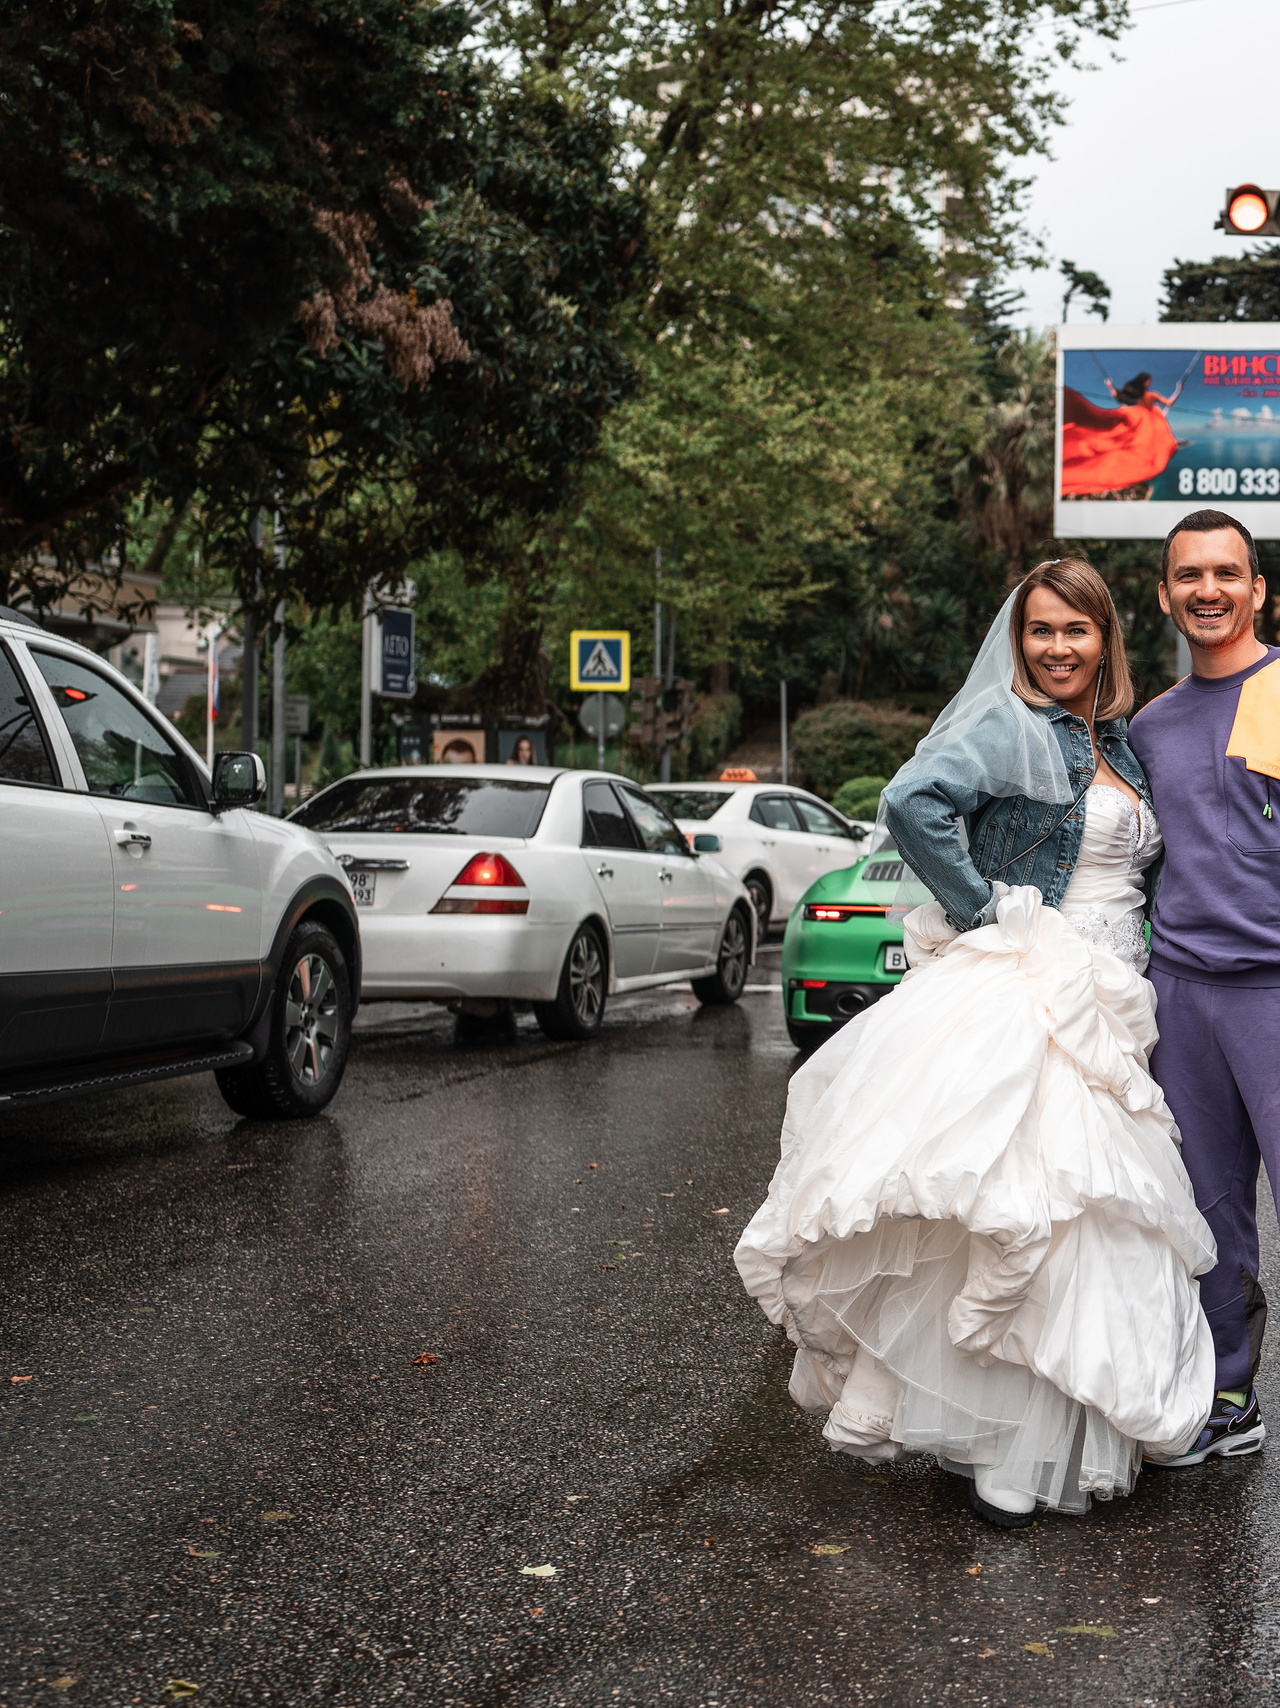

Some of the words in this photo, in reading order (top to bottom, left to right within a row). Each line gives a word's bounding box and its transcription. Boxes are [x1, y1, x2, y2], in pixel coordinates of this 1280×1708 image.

[1178, 468, 1194, 495] 8
[1196, 468, 1237, 495] 800
[1240, 468, 1280, 495] 333
[348, 873, 366, 888] 98
